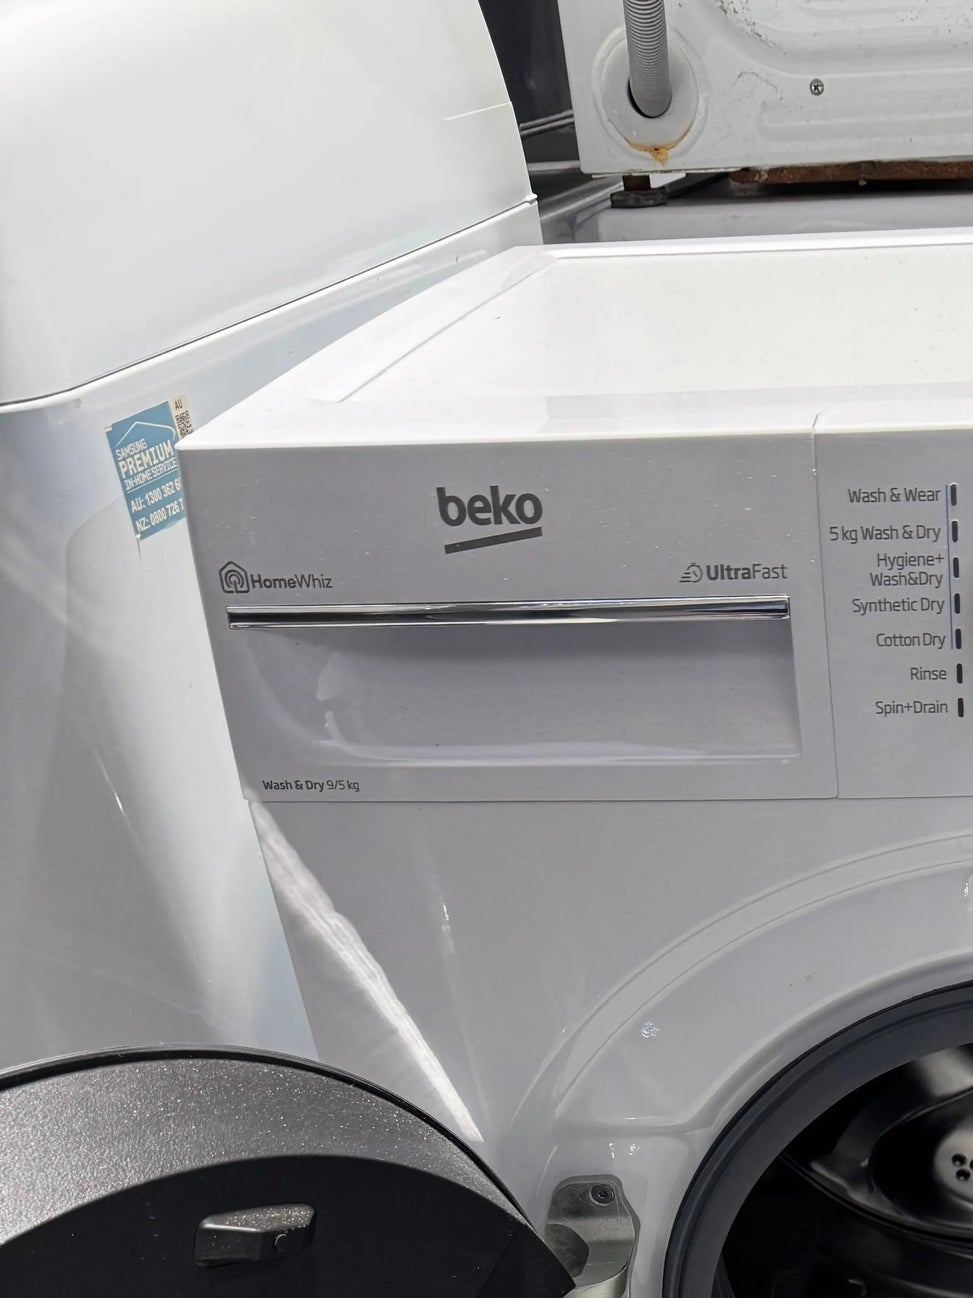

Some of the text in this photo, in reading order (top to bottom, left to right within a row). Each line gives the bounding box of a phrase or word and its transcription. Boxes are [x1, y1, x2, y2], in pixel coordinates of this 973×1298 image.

[115, 438, 147, 460] SAMSUNG
[119, 440, 174, 479] PREMIUM
[125, 457, 178, 490] IN-HOME SERVICE
[130, 497, 145, 513] AU:
[145, 488, 162, 506] 1300
[848, 488, 941, 503] Wash & Wear
[436, 486, 543, 526] beko
[135, 518, 150, 533] NZ:
[149, 508, 167, 526] 0800
[830, 525, 941, 544] 5 kg Wash & Dry
[877, 553, 945, 570] Hygiene+
[706, 562, 788, 582] UltraFast
[870, 572, 944, 588] Wash&Dry
[251, 574, 333, 590] HomeWhiz
[852, 598, 945, 616] Synthetic Dry
[876, 633, 946, 648] Cotton Dry
[910, 667, 947, 681] Rinse
[875, 701, 948, 717] Spin+Drain
[263, 779, 360, 793] Wash & Dry 9/5 kg
